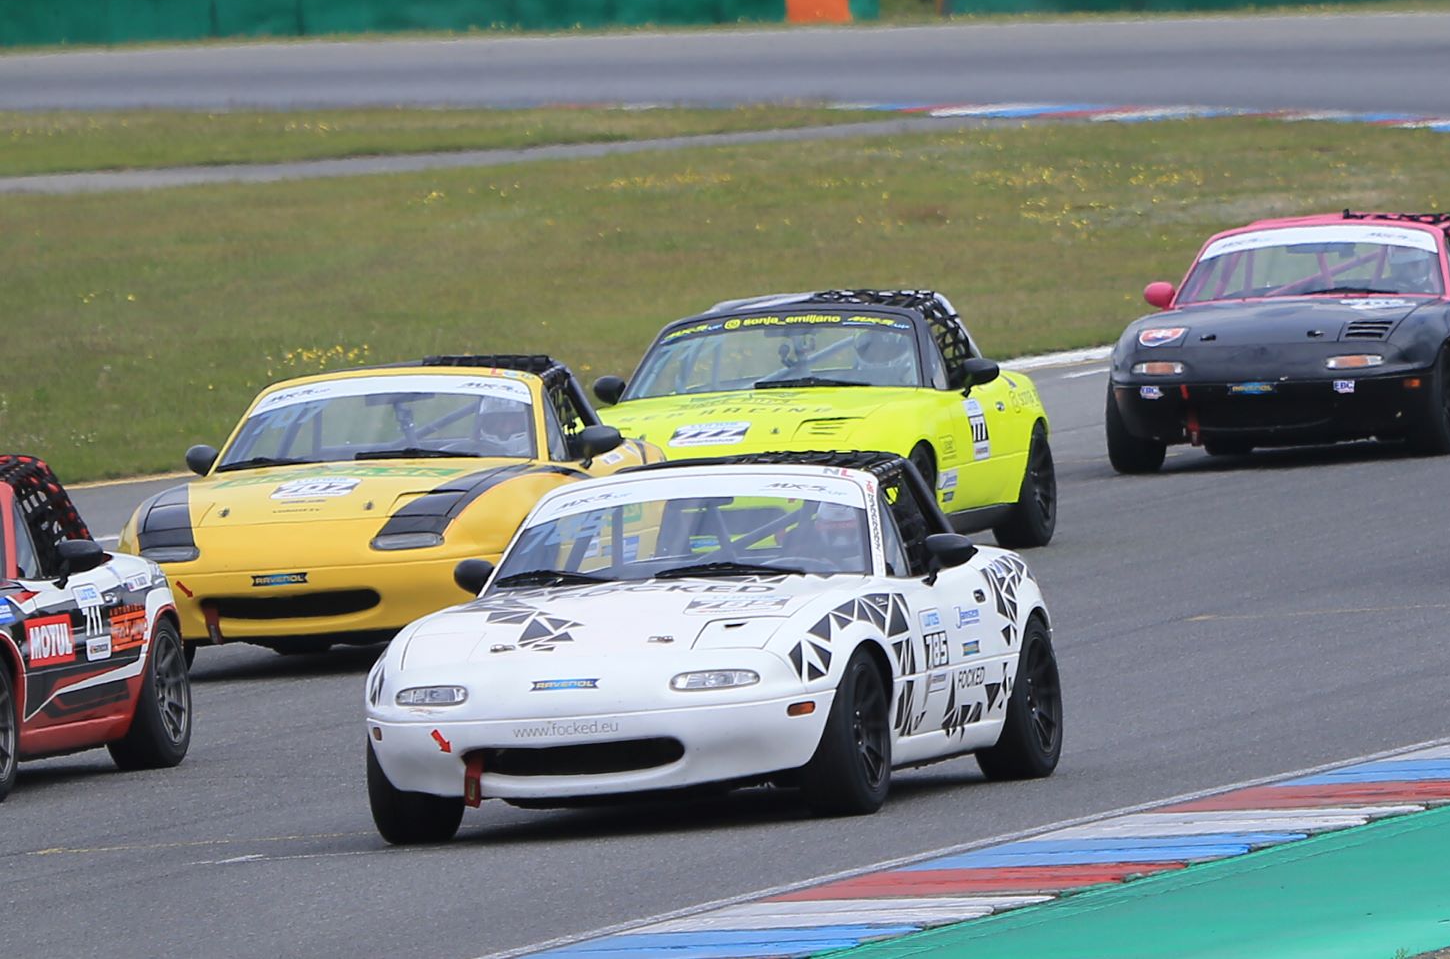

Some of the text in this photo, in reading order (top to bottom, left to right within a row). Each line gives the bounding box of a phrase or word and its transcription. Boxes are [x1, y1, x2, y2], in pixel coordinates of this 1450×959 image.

[255, 574, 305, 584] RAVENOL
[546, 584, 777, 603] FOCKED
[82, 605, 104, 637] 711
[29, 623, 73, 660] MOTUL
[925, 632, 948, 668] 785
[534, 679, 598, 690] RAVENOL
[957, 666, 985, 689] FOCKED
[513, 720, 620, 738] www.focked.eu
